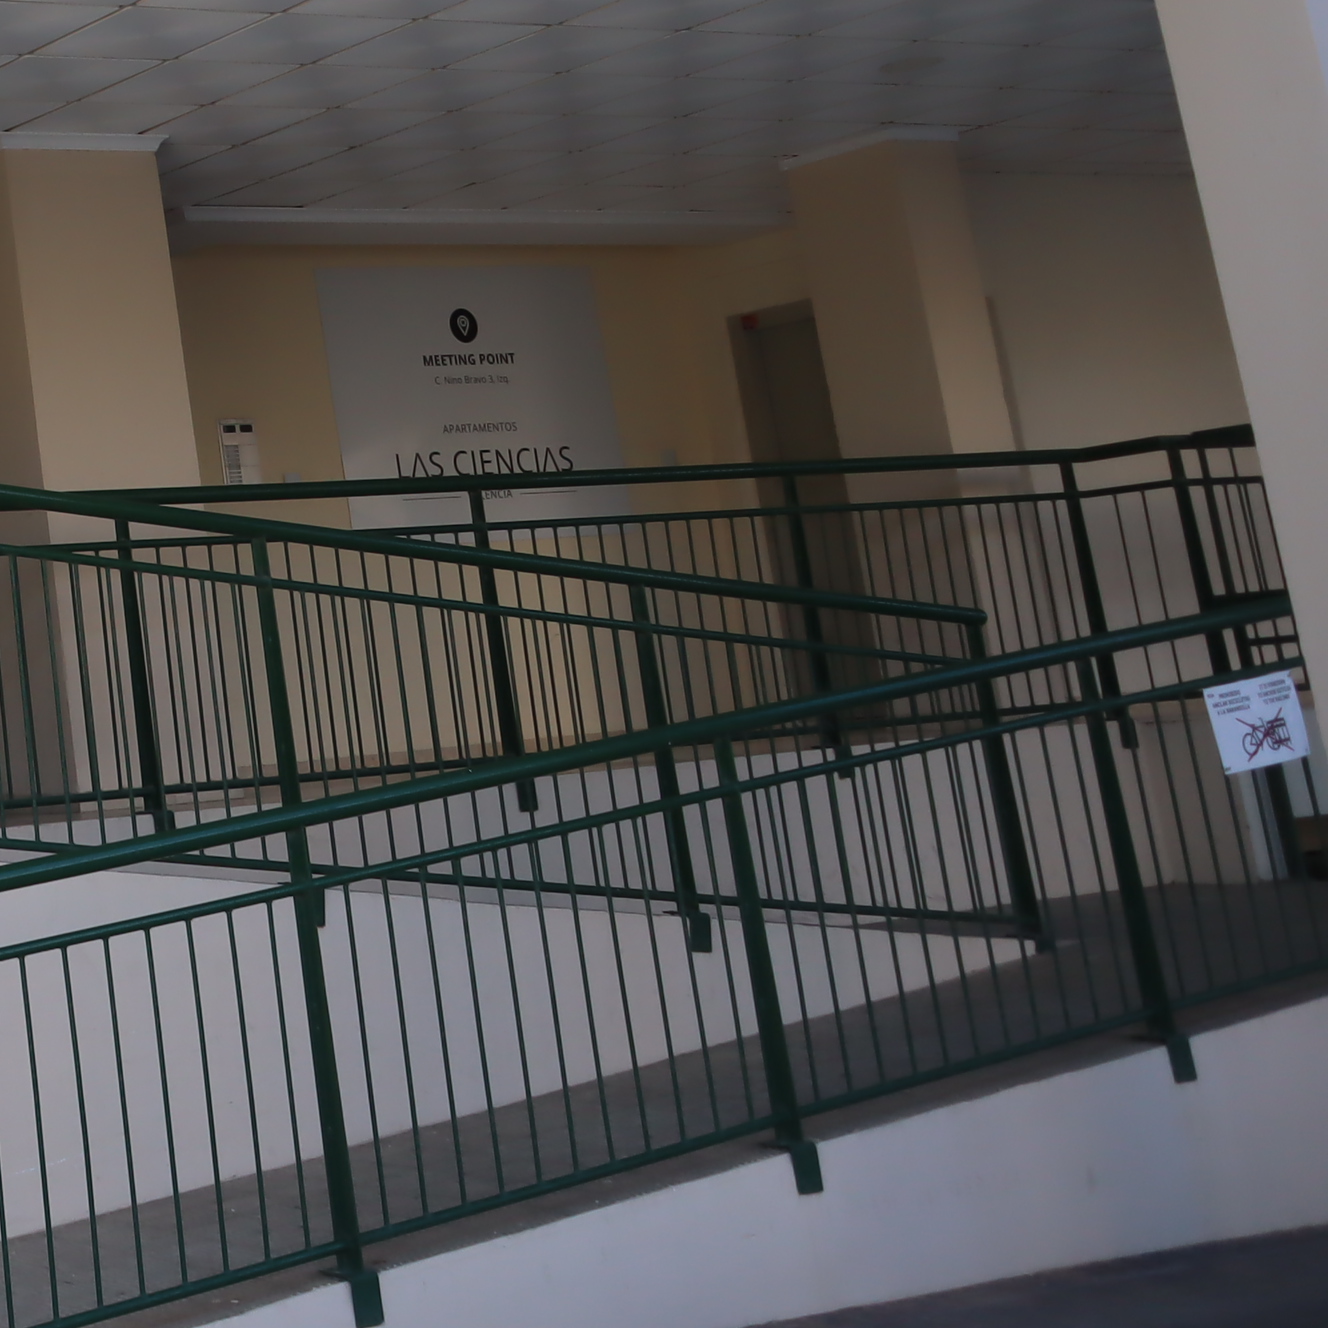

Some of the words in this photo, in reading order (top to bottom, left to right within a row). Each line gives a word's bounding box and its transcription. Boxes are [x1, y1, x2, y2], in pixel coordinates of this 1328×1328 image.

[422, 354, 476, 367] MEETING
[479, 353, 515, 365] POINT
[444, 376, 463, 385] Nino
[464, 375, 487, 384] Bravo
[443, 422, 518, 434] APARTAMENTOS
[395, 451, 444, 478] LAS
[453, 445, 574, 476] CIENCIAS
